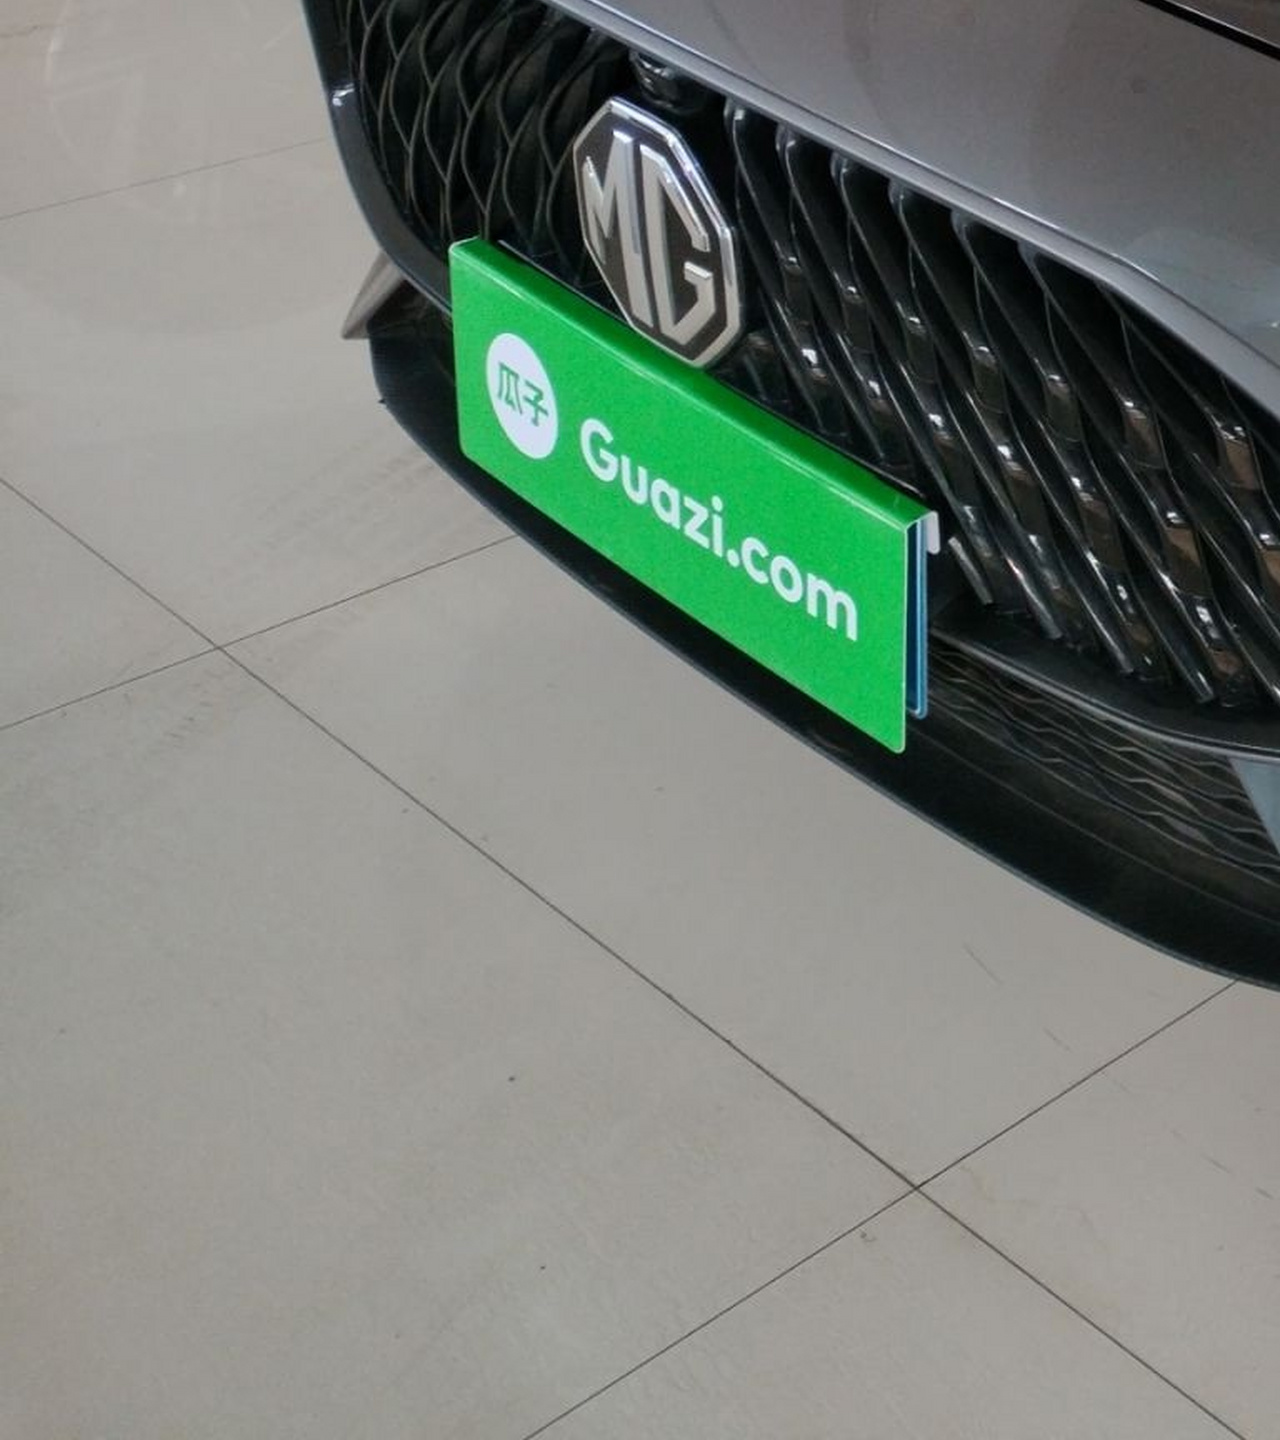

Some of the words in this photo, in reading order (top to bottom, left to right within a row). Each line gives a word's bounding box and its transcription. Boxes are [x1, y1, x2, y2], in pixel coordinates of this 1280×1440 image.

[584, 129, 717, 348] MG
[497, 361, 550, 428] 瓜子
[579, 417, 858, 642] Guazi.com
